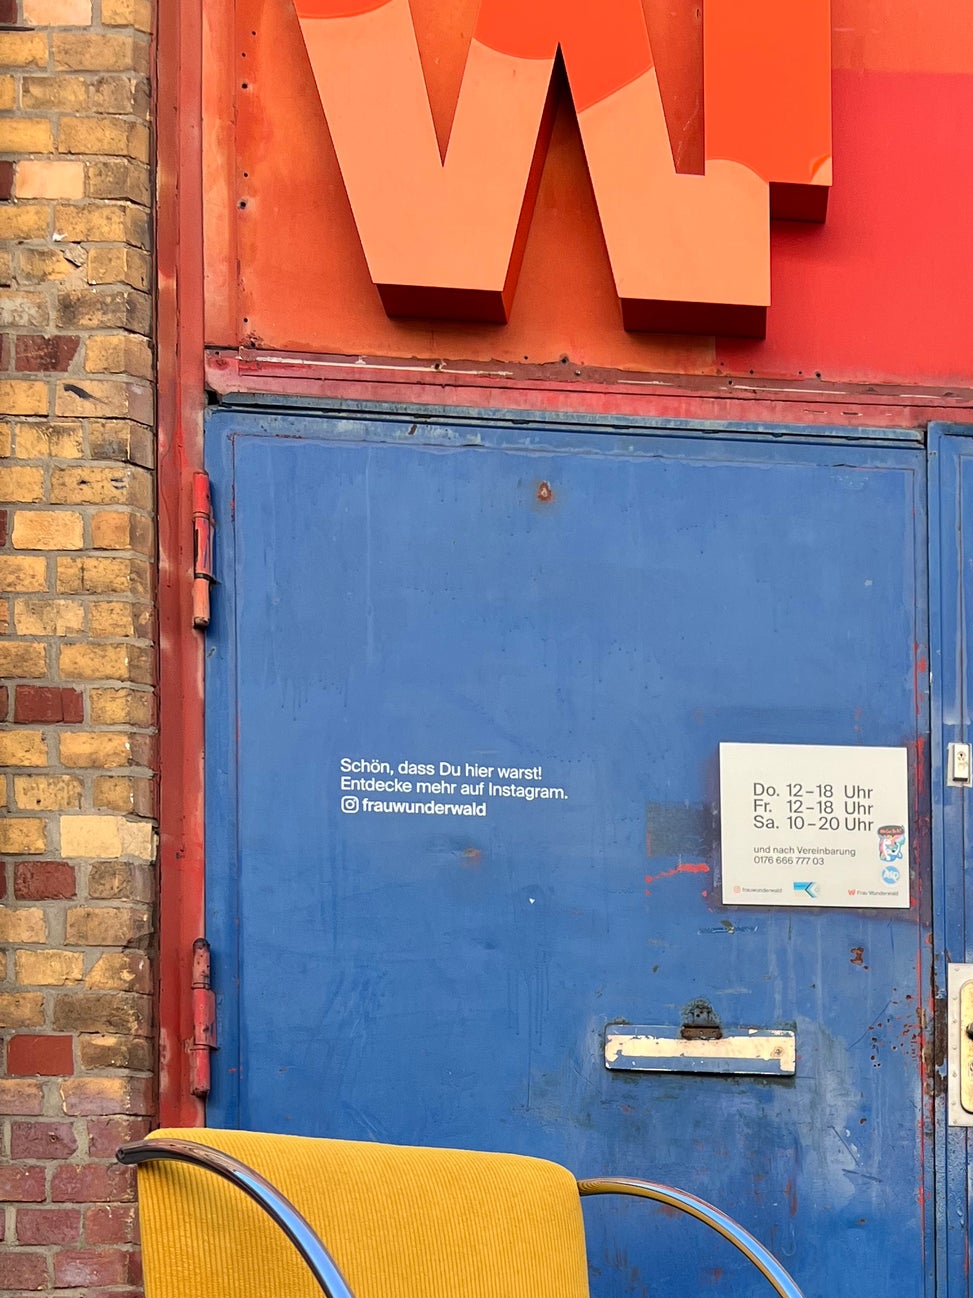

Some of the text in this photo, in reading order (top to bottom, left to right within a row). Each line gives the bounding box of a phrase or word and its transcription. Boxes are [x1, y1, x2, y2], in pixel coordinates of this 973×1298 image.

[340, 758, 542, 780] Schön, dass Du hier warst!
[341, 776, 568, 801] Entdecke mehr auf Instagram.
[753, 782, 780, 797] Do.
[844, 785, 874, 799] Uhr
[362, 798, 487, 817] frauwunderwald
[753, 798, 773, 813] Fr.
[844, 801, 874, 815] Uhr
[753, 815, 779, 829] Sa.
[845, 817, 874, 831] Uhr
[753, 846, 856, 857] und nach Vereinbarung
[753, 856, 825, 866] 0176 666 777 03
